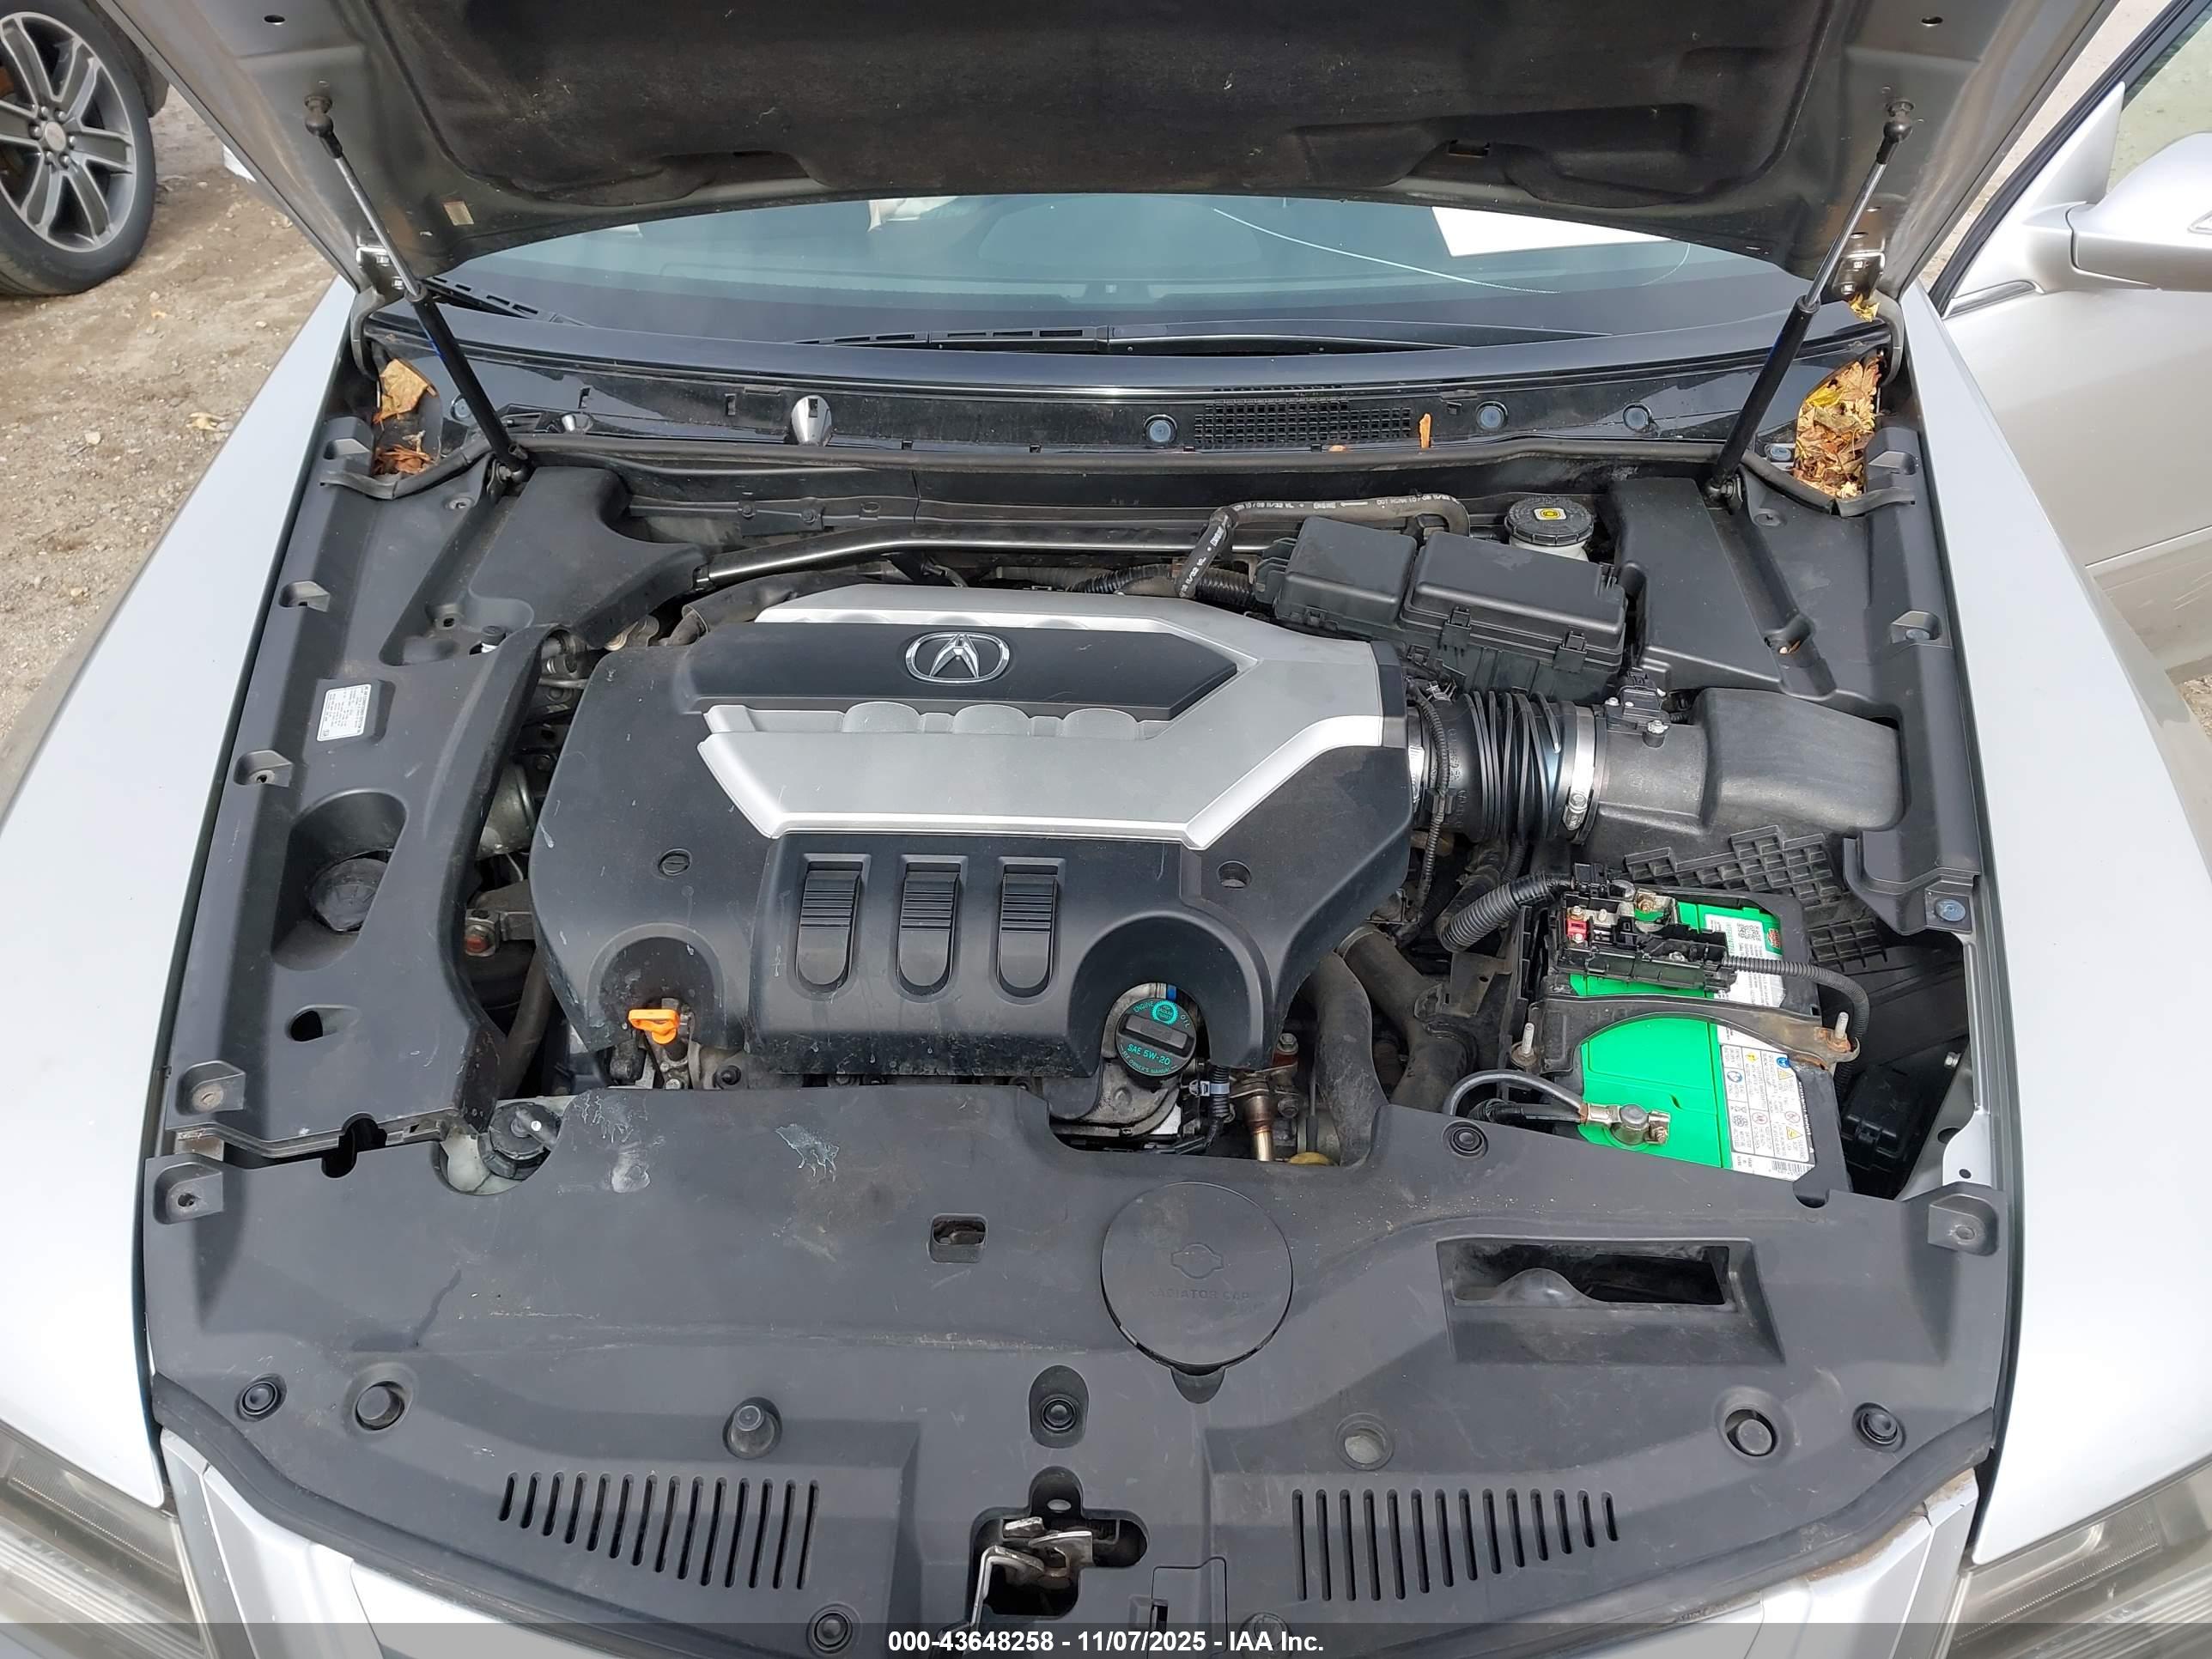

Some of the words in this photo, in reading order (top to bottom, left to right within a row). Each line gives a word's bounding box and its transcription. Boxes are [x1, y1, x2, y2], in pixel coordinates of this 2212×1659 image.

[1133, 1001, 1154, 1012] ENGINE
[1181, 1014, 1191, 1028] OIL
[1127, 1043, 1142, 1055] SAE
[1143, 1049, 1170, 1066] 5W-20
[1148, 1288, 1218, 1299] RADIATOR
[1222, 1291, 1249, 1300] CAP
